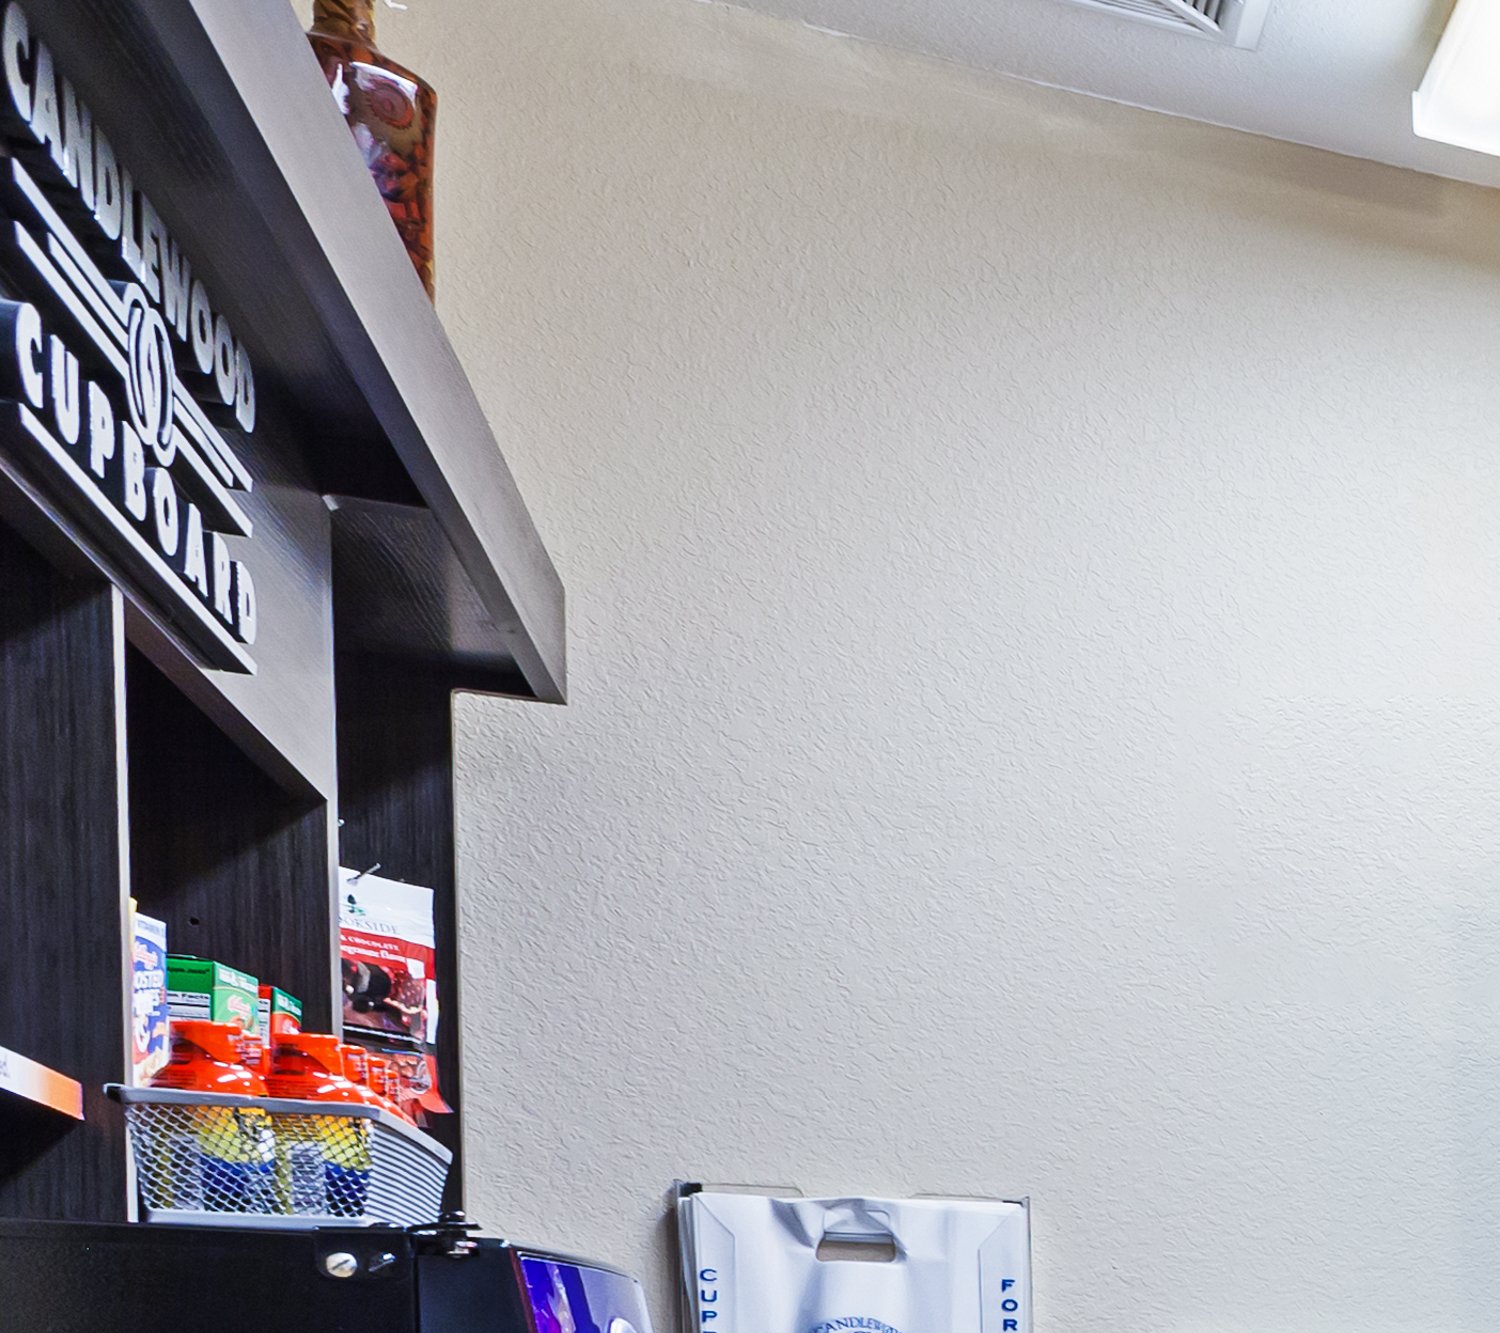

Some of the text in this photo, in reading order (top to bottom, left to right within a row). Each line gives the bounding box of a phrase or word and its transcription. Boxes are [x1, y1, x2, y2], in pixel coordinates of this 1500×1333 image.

[3, 2, 256, 433] CANDLEWOOD
[15, 302, 257, 645] CUPBOARD
[1001, 1279, 1018, 1332] FOR
